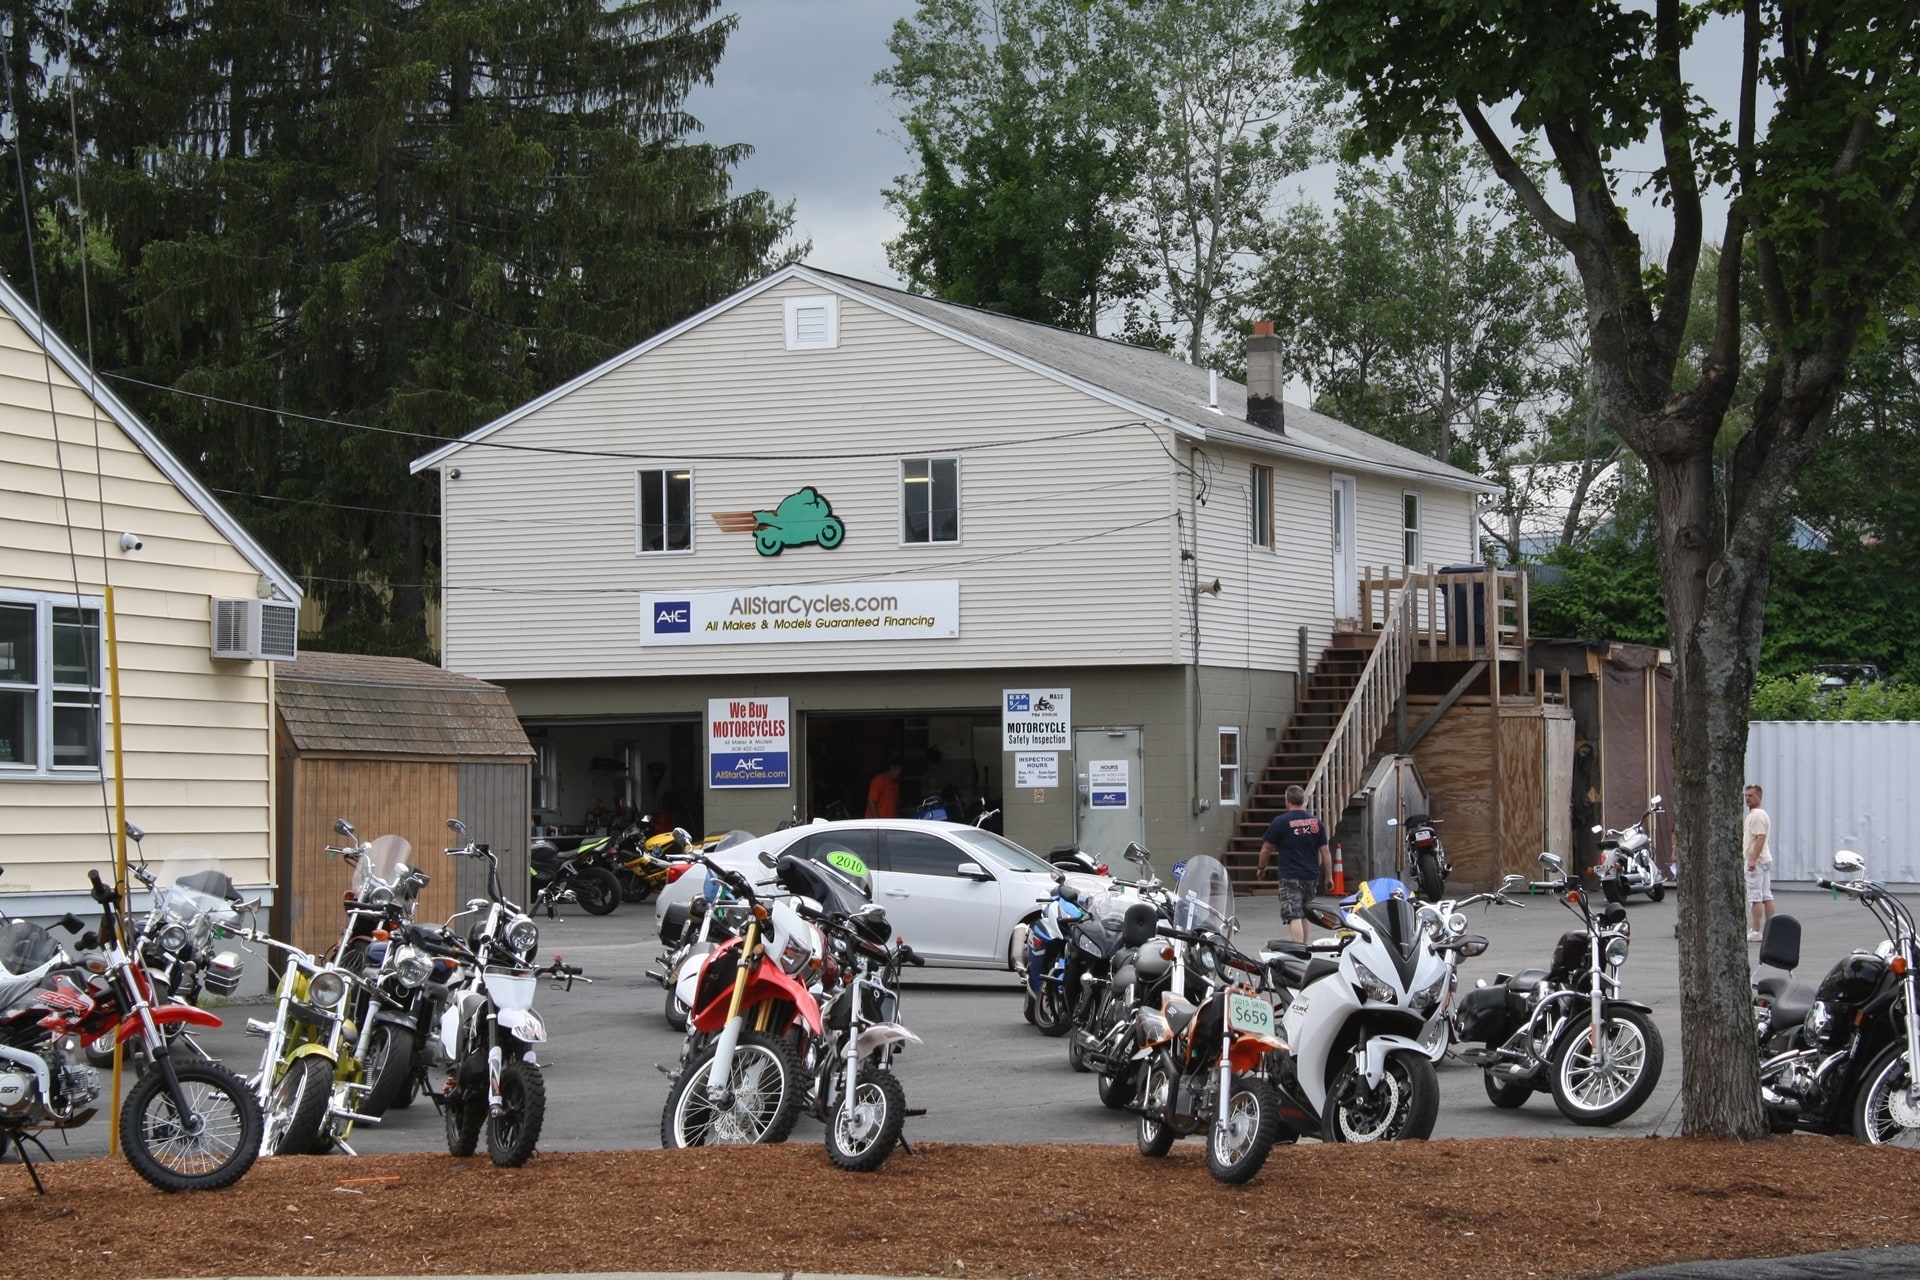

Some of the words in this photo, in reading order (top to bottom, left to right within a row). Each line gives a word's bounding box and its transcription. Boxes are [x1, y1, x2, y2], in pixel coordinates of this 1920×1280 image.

[729, 594, 898, 618] AllStarCycles.com
[705, 621, 719, 631] All
[722, 620, 756, 631] Makes
[760, 619, 769, 630] &
[774, 617, 812, 629] Models
[815, 616, 880, 629] Guaranteed
[884, 615, 935, 628] Financing
[729, 702, 747, 719] We
[748, 701, 768, 719] Buy
[713, 719, 786, 738] MOTORCYCLES
[1007, 722, 1066, 734] MOTORCYCLE
[1008, 734, 1030, 746] Safety
[1032, 734, 1066, 746] Inspection
[715, 770, 787, 780] AllStarCycles.com
[835, 855, 863, 873] 2010
[1234, 998, 1250, 1007] 2015
[1235, 1006, 1268, 1026] $659
